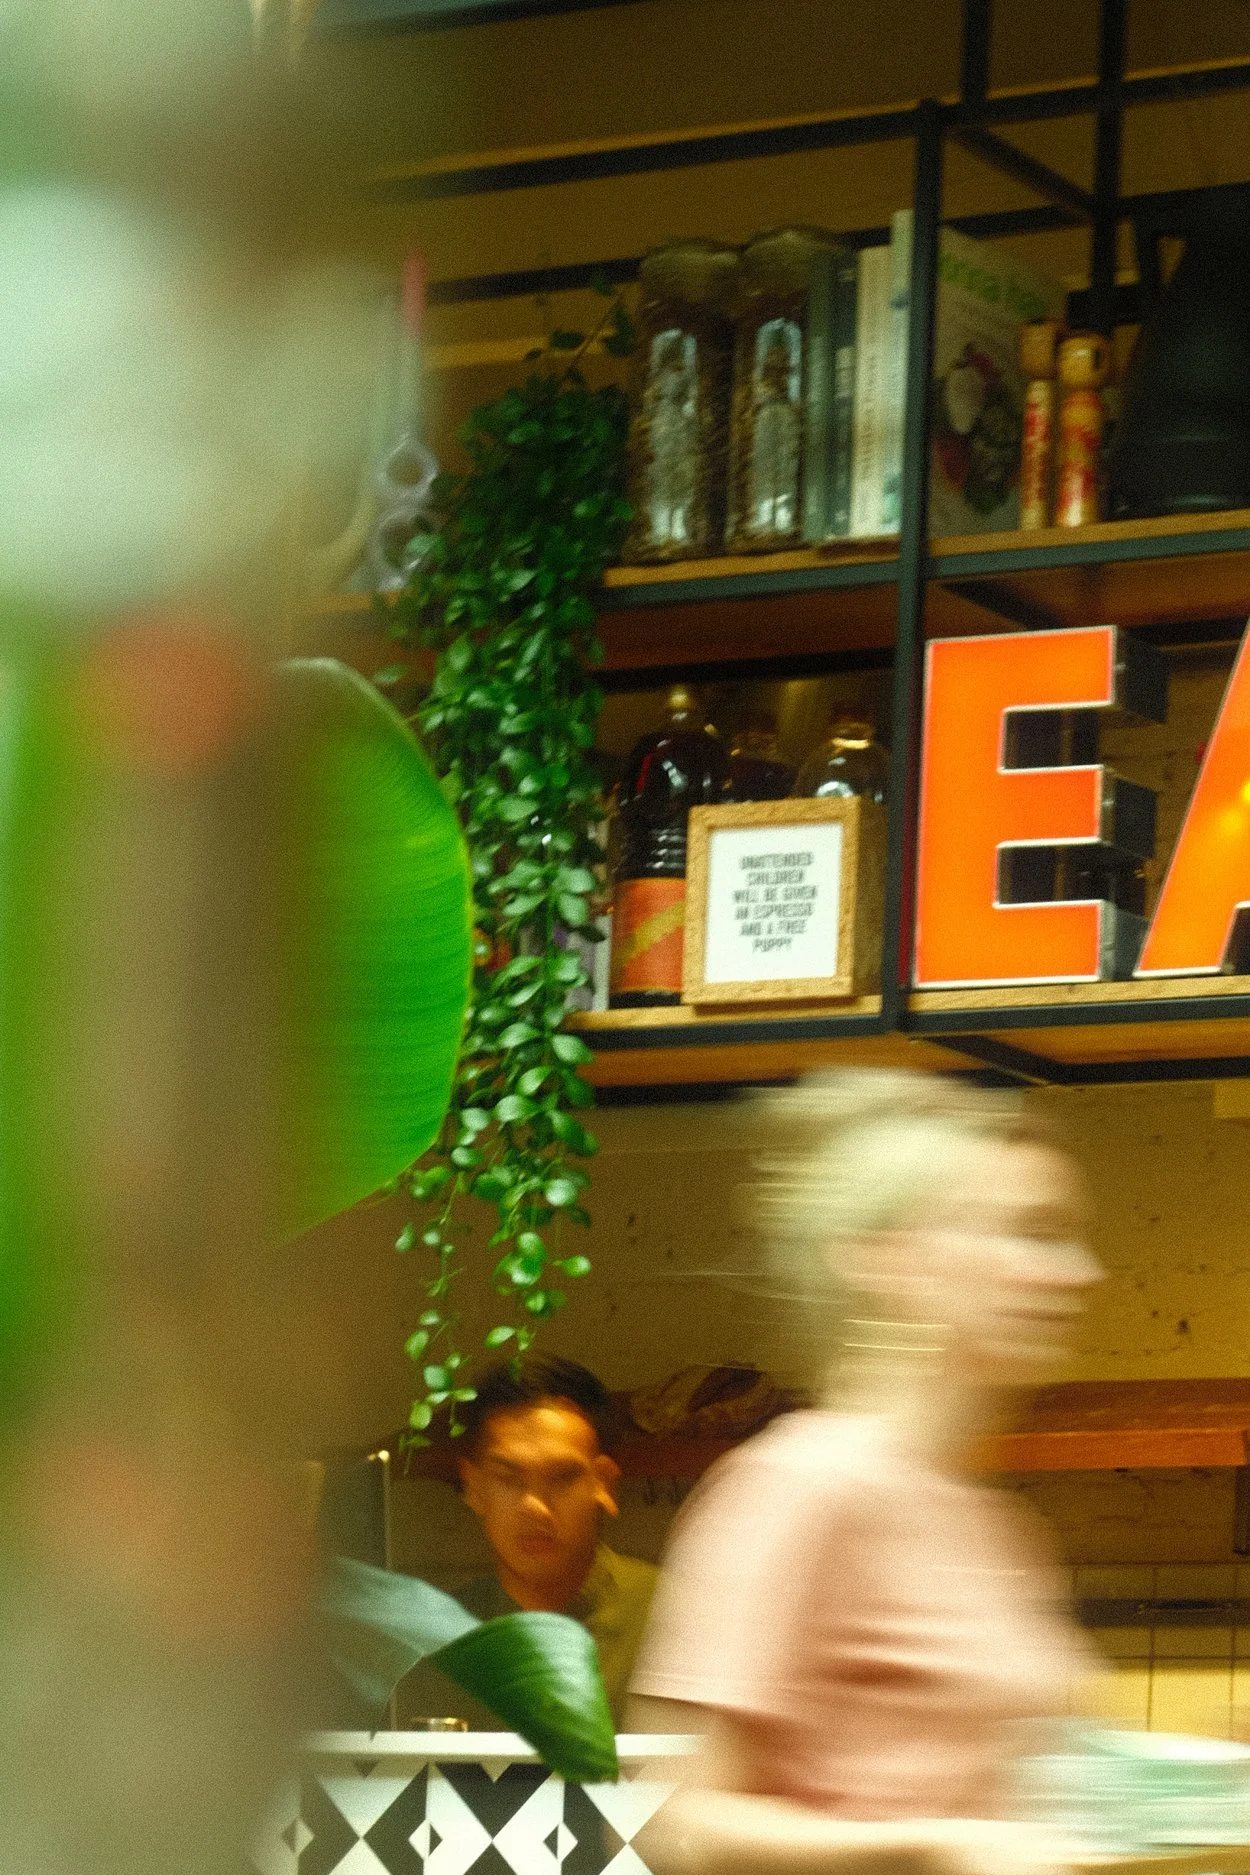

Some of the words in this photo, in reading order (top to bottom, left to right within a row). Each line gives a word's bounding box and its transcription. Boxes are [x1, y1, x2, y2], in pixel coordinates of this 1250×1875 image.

[740, 852, 813, 869] UNATTENDED
[746, 870, 804, 885] CHILDREN
[734, 889, 759, 903] WILL
[765, 887, 778, 902] BE
[782, 886, 818, 901] GIVEN
[736, 905, 749, 920] AN
[754, 902, 814, 919] ESPRESSO
[740, 921, 761, 936] AND
[779, 918, 806, 935] FREE
[753, 937, 792, 953] PUPPY
